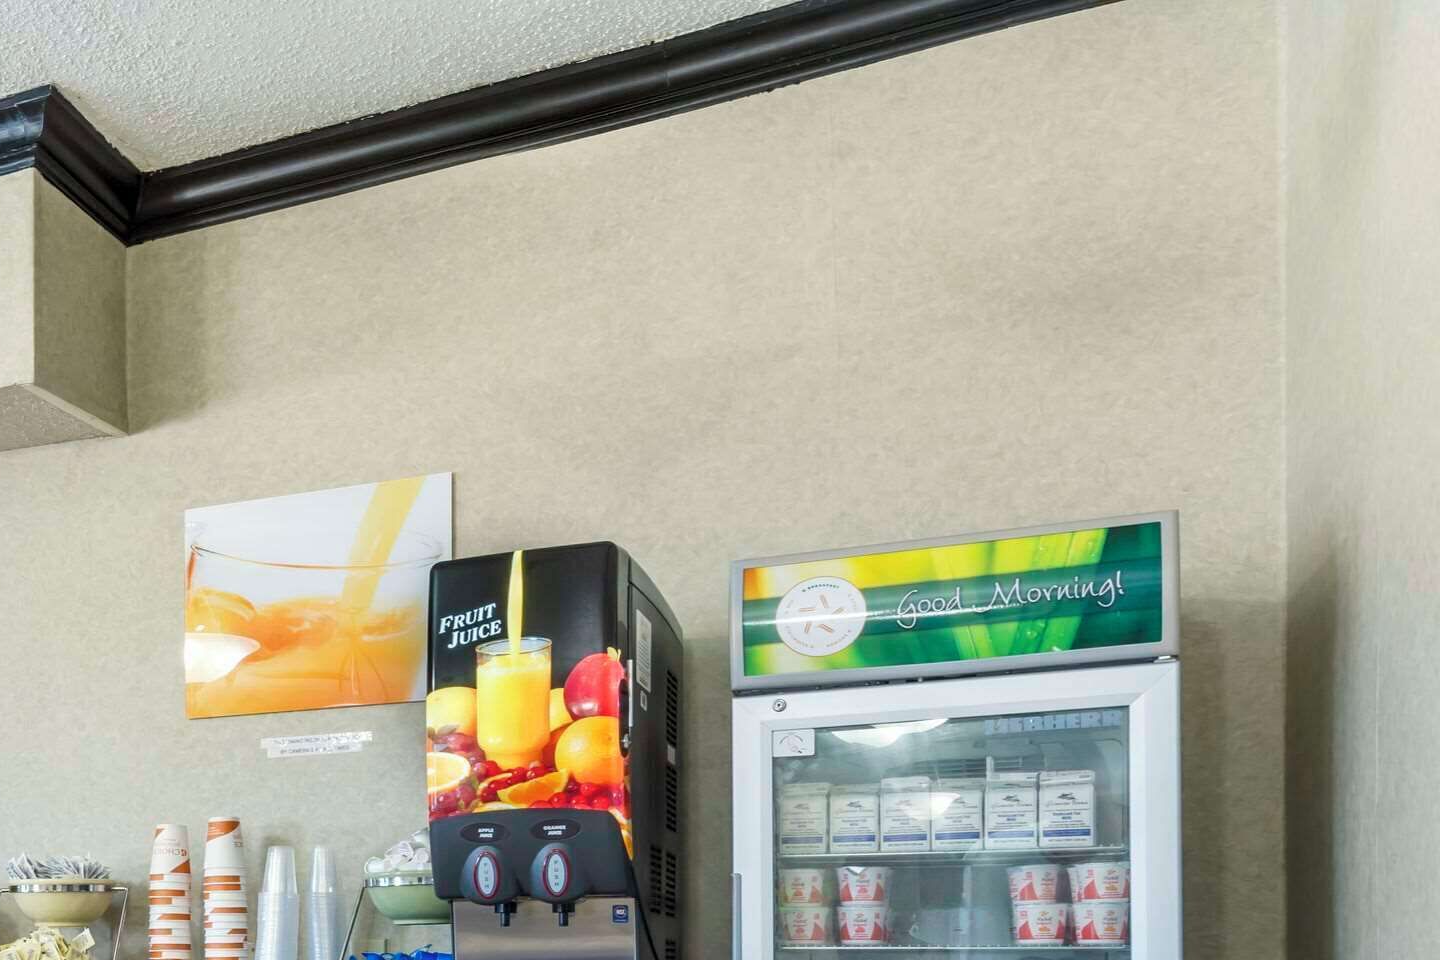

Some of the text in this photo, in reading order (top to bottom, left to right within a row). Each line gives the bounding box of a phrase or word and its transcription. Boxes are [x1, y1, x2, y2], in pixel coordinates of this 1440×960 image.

[896, 587, 962, 629] Good
[972, 570, 1125, 613] Morning!
[438, 602, 497, 634] FRUIT
[448, 620, 502, 649] JUICE
